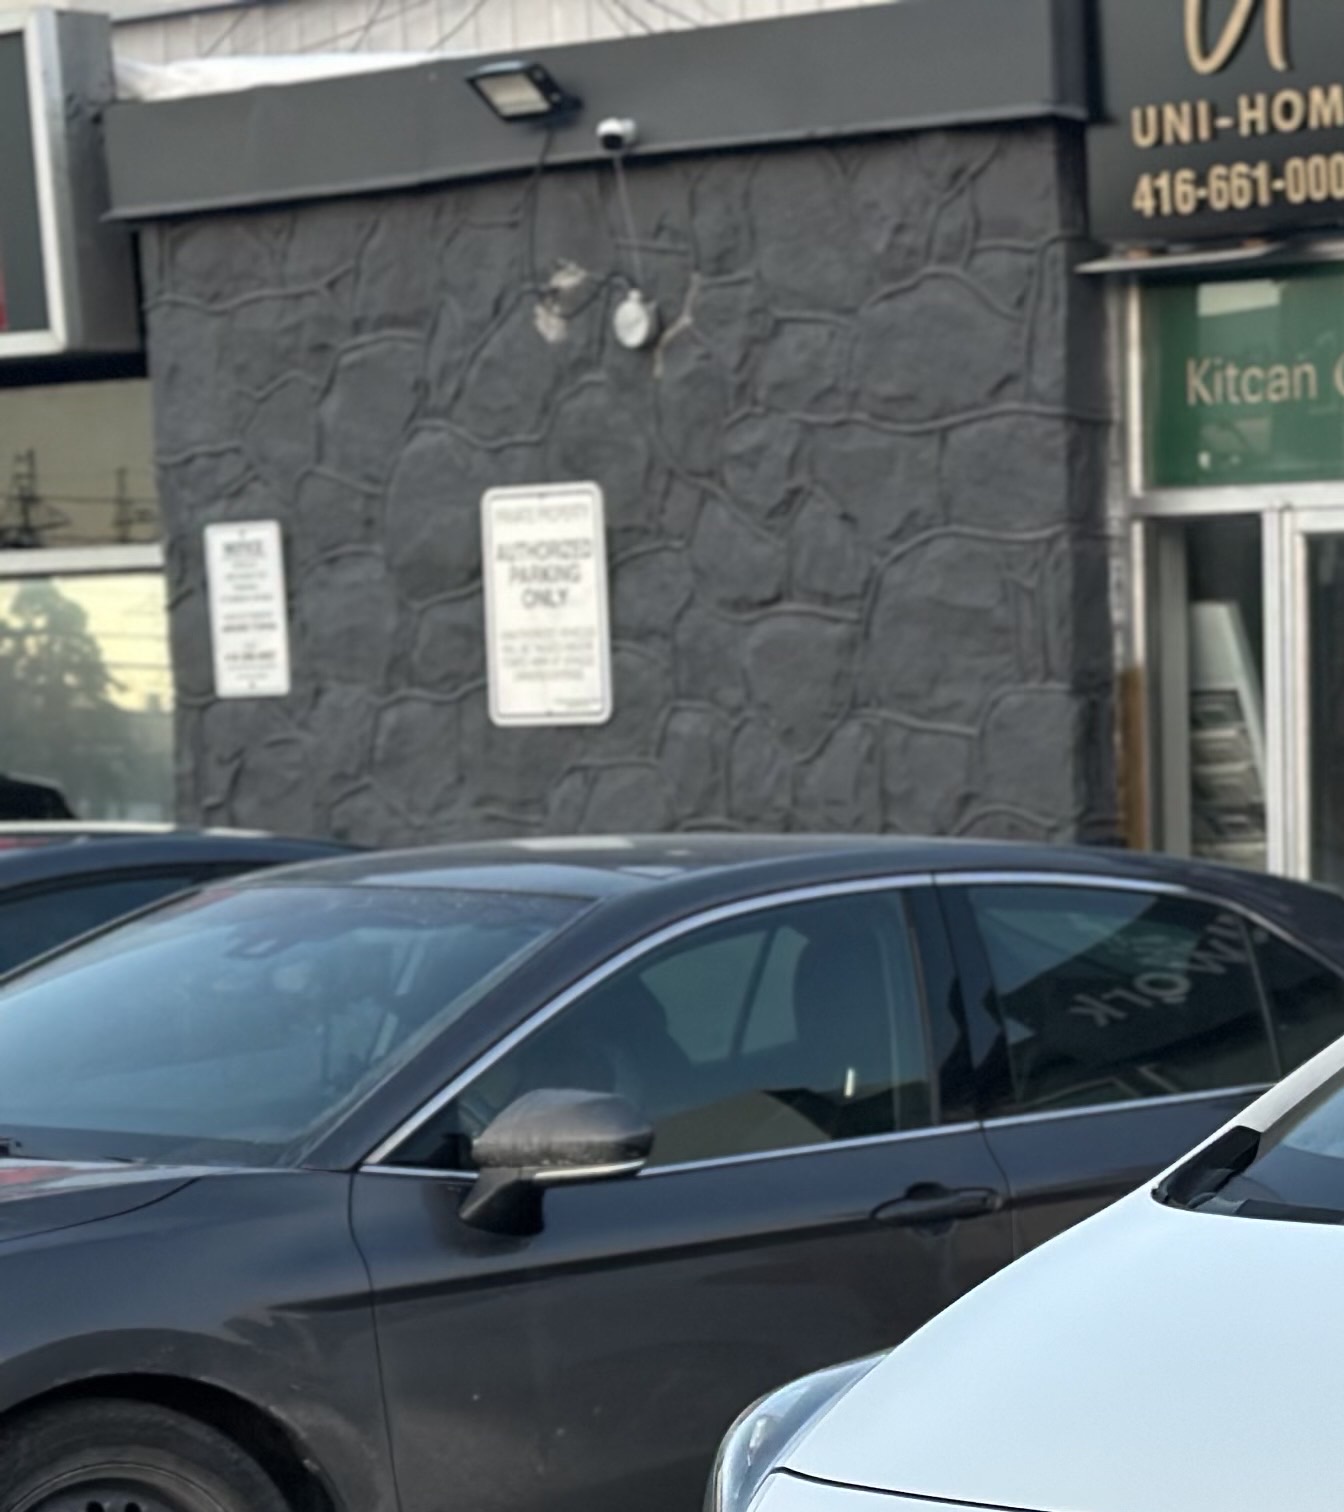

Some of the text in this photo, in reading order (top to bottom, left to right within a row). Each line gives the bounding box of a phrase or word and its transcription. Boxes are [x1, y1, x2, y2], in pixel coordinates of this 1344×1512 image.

[1186, 356, 1318, 406] Kitcan
[496, 537, 592, 563] AUTHORIZED
[509, 562, 582, 586] PARKING
[521, 587, 568, 609] ONLY
